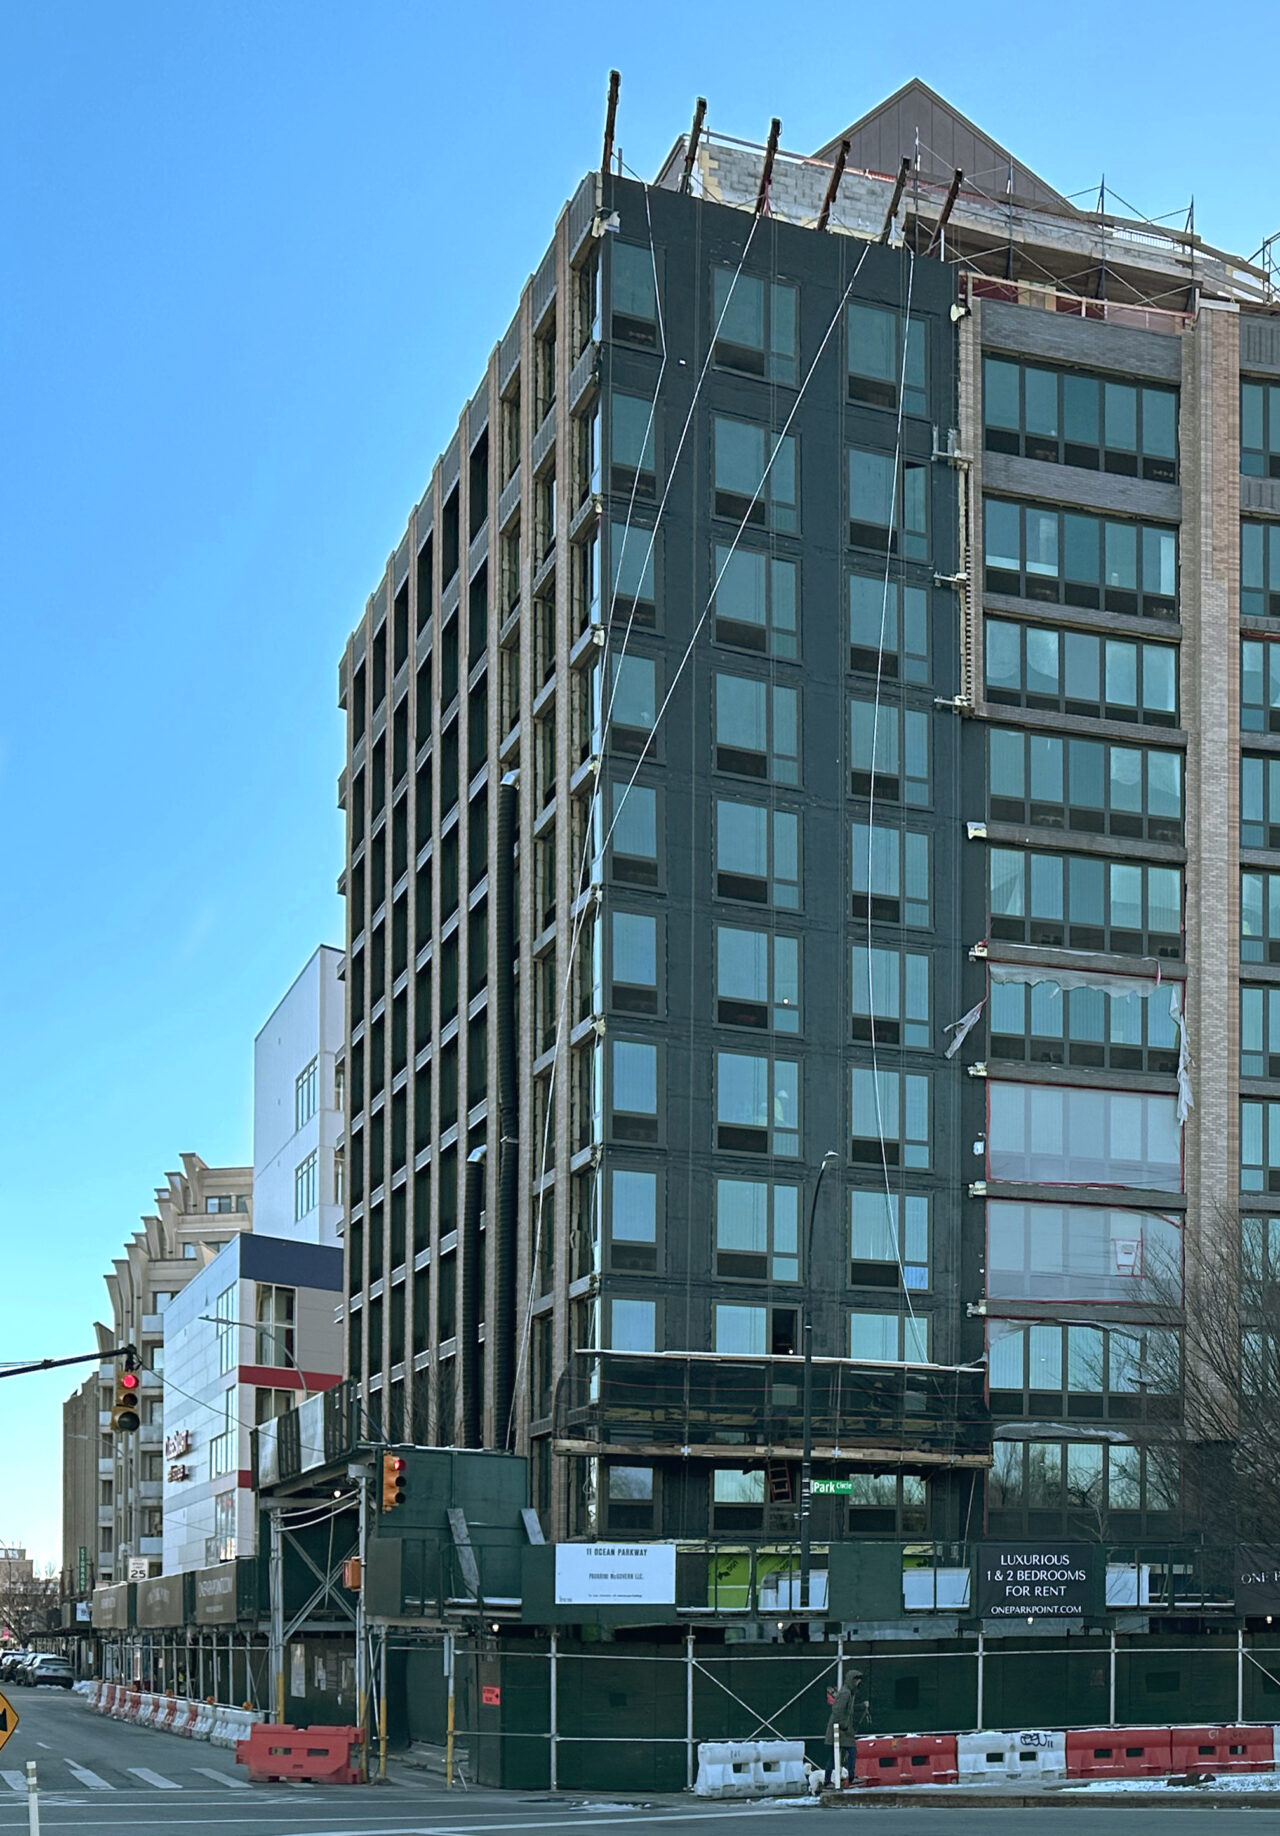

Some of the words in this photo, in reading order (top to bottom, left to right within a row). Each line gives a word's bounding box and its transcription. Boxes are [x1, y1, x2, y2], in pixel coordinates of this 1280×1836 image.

[814, 1481, 835, 1493] Park
[586, 1548, 592, 1556] 11
[594, 1548, 615, 1556] OCEAN
[1000, 1554, 1070, 1566] LUXURIOUS
[131, 1569, 146, 1578] 25
[987, 1570, 991, 1581] 1
[994, 1570, 1004, 1581] &
[1006, 1570, 1014, 1581] 2
[1016, 1570, 1087, 1581] BEDROOMS
[1006, 1586, 1031, 1597] FOR
[1034, 1586, 1067, 1597] RENT
[991, 1605, 1082, 1615] ONEPARKPOINT.COM
